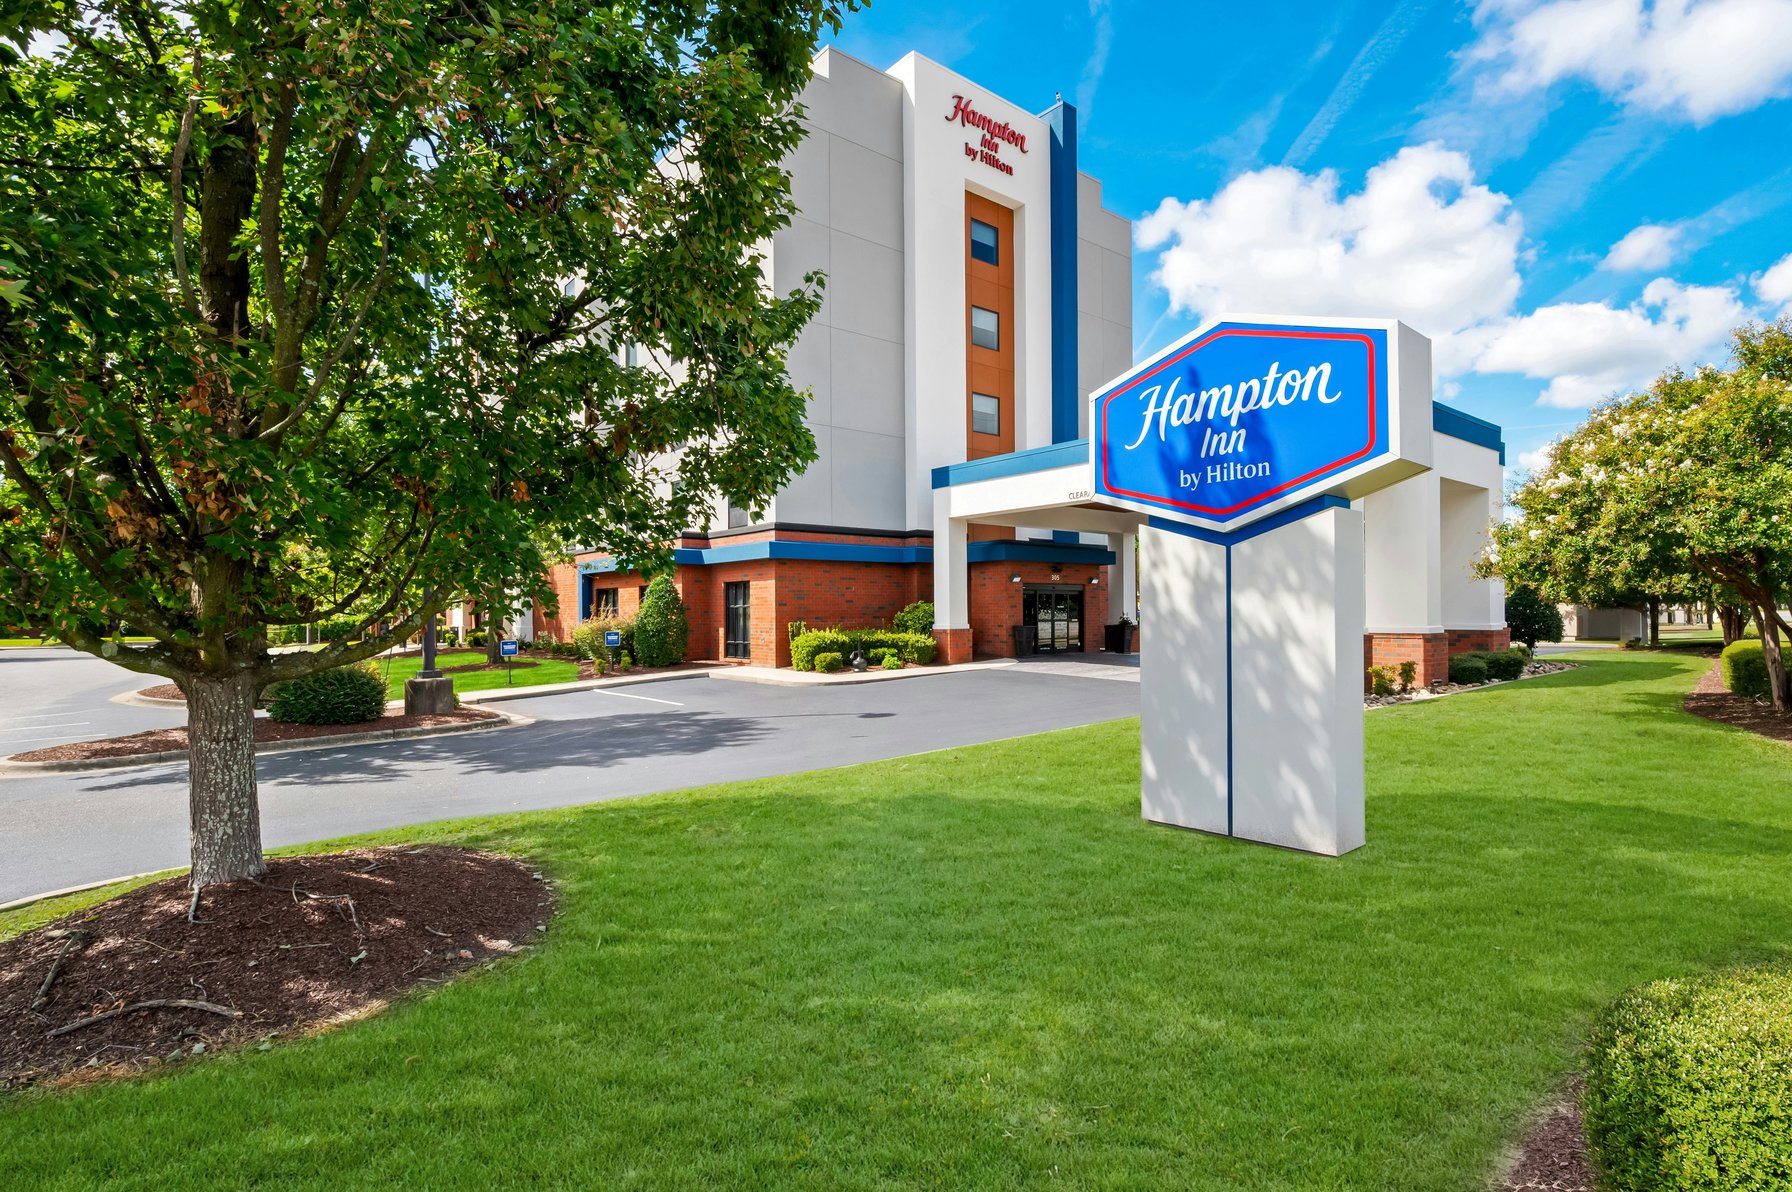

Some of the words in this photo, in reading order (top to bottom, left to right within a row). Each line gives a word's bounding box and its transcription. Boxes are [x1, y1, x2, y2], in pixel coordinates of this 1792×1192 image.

[945, 95, 1028, 154] Hampton
[965, 142, 979, 161] by
[980, 150, 1013, 176] Hilton
[981, 134, 1000, 153] Inn
[1124, 361, 1342, 450] Hampton
[1200, 427, 1247, 459] Inn
[1179, 469, 1202, 491] by
[1206, 461, 1271, 484] Hilton
[1068, 490, 1090, 500] CLEAR
